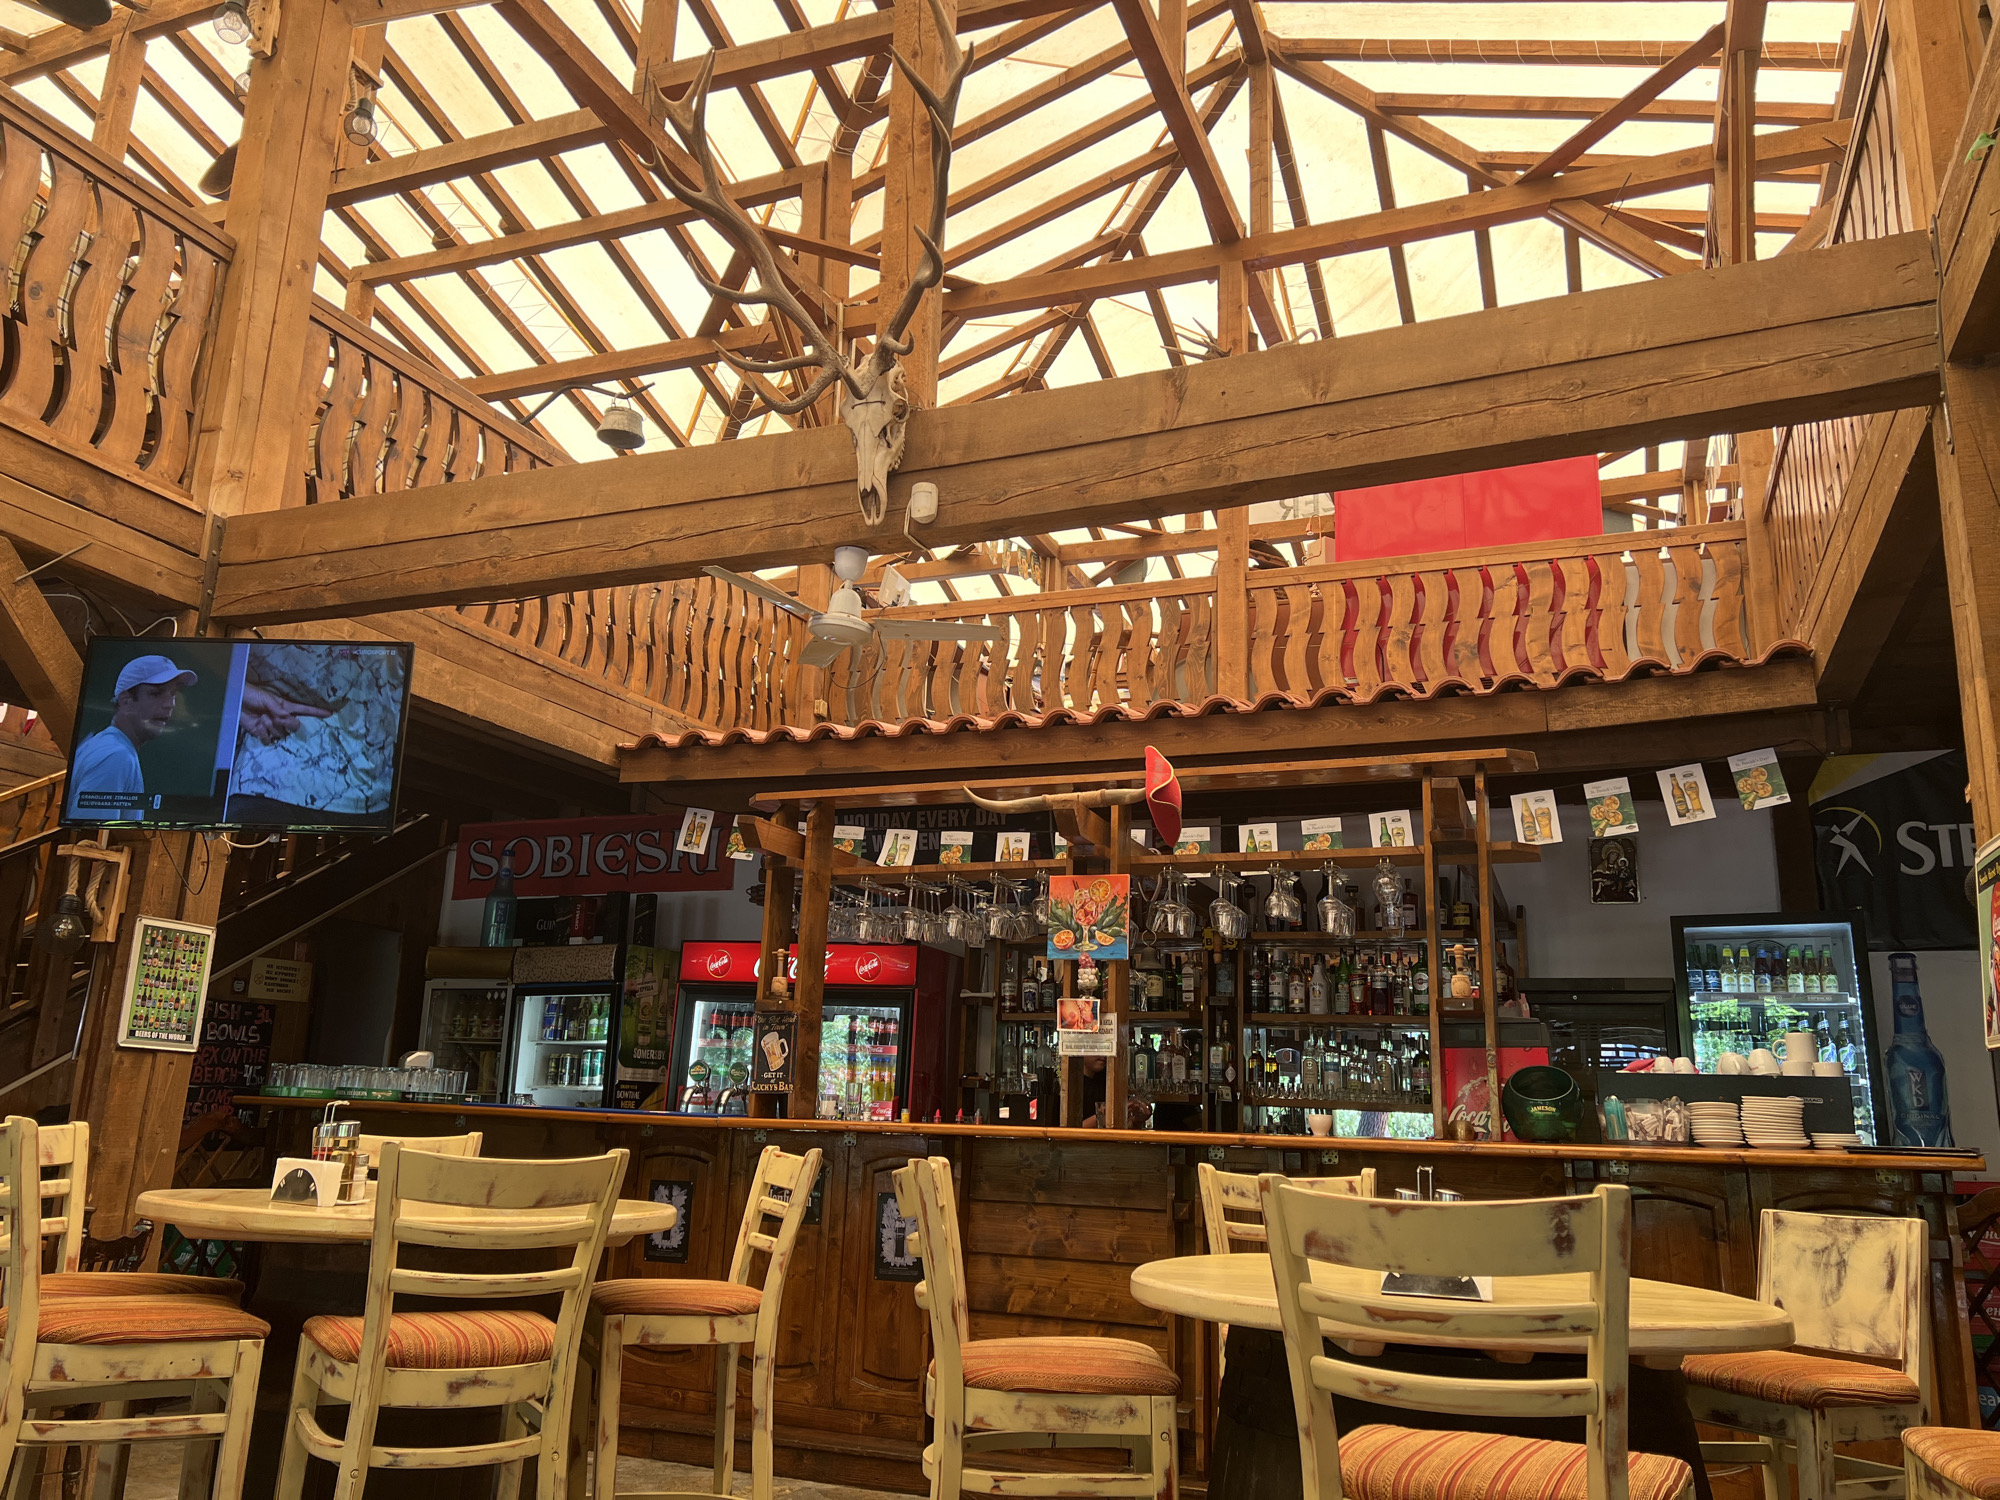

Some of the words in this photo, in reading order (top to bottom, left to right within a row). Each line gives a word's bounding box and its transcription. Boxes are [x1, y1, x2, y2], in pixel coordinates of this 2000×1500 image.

[843, 810, 911, 830] HOLIDAY
[916, 808, 971, 830] EVERY
[975, 806, 1008, 828] DAY
[1205, 937, 1235, 946] BSS
[134, 1030, 152, 1039] BEERS
[168, 1033, 186, 1041] WORLD
[206, 1021, 261, 1044] BOWLS
[221, 1047, 241, 1065] ON
[242, 1047, 268, 1065] THE
[633, 1047, 666, 1061] SOMERSBY
[620, 1100, 636, 1109] HERE
[1530, 1105, 1557, 1113] JAMESON
